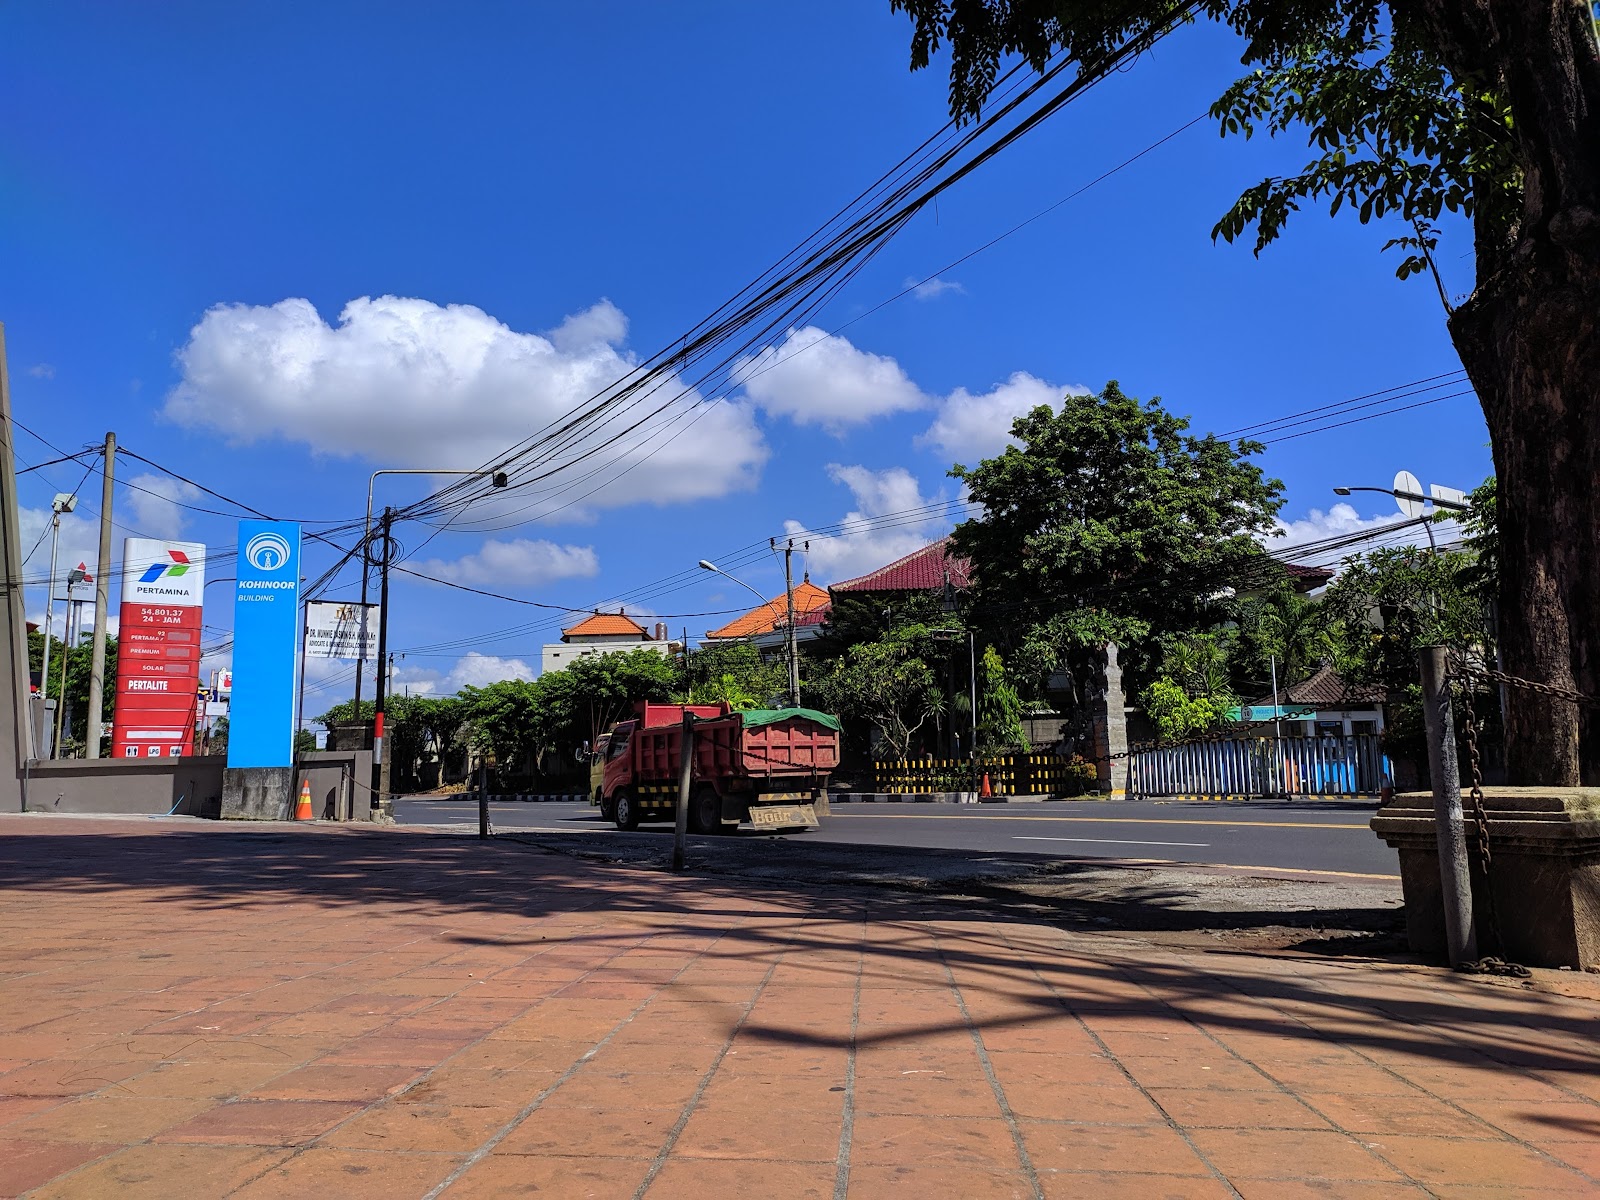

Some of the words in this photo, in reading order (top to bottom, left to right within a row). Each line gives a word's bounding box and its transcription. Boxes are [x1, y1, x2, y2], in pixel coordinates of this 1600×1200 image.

[238, 580, 295, 589] KOHINOOR
[136, 586, 190, 596] PERTAMINA
[237, 594, 274, 602] BUILDING
[141, 608, 183, 616] 54.801.37
[142, 615, 153, 623] 24
[162, 616, 181, 624] JAM
[128, 680, 168, 690] PERTALITE
